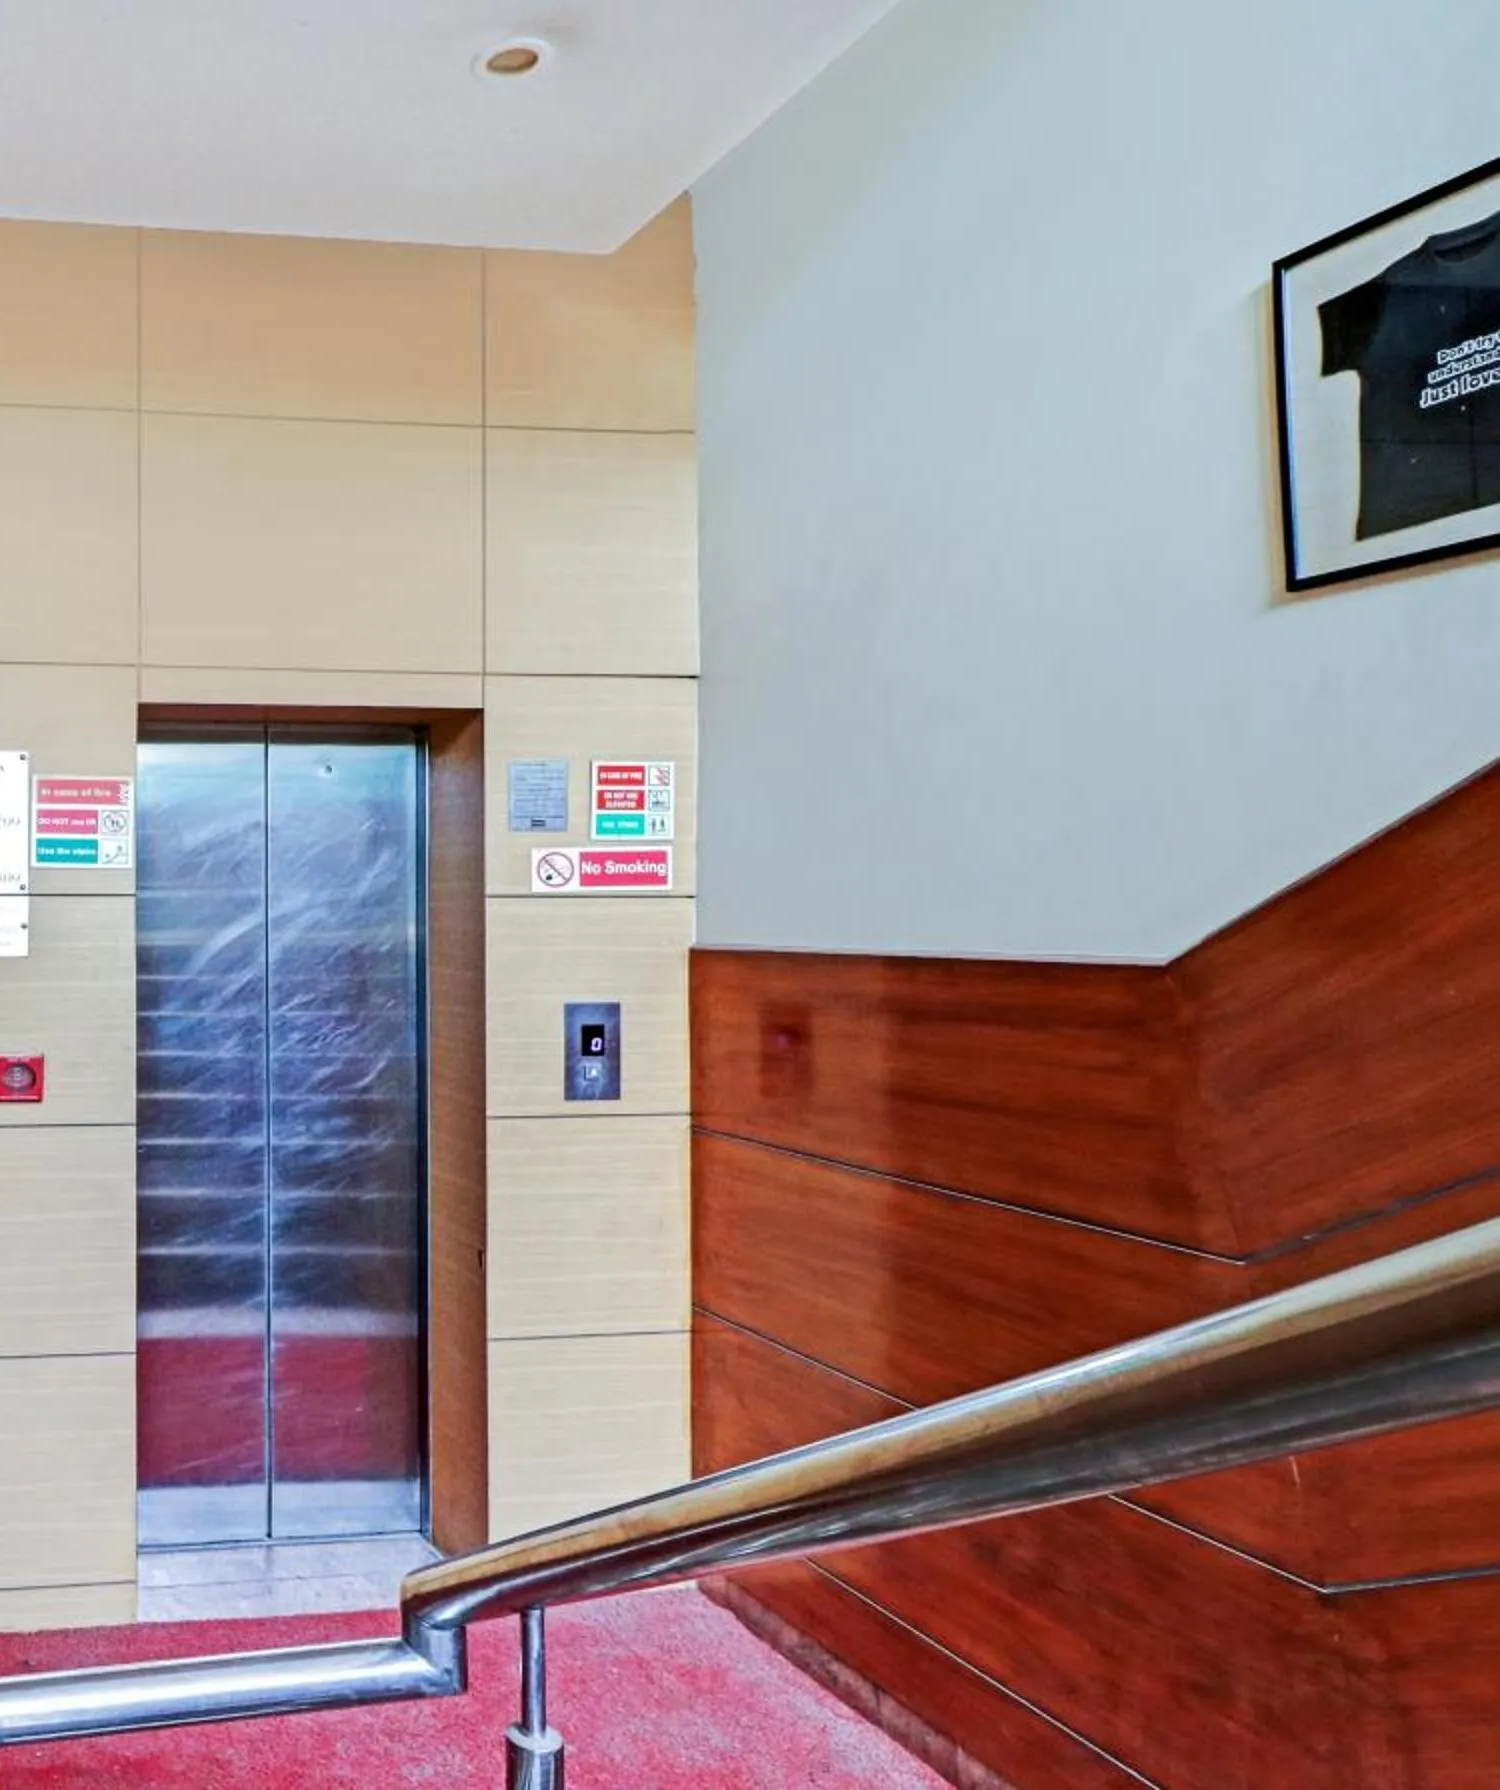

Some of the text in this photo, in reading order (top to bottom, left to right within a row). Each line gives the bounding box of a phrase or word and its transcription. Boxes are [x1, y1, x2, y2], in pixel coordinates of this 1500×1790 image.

[1437, 339, 1476, 365] Don't
[1419, 379, 1459, 408] Just
[581, 859, 667, 878] No Smoking
